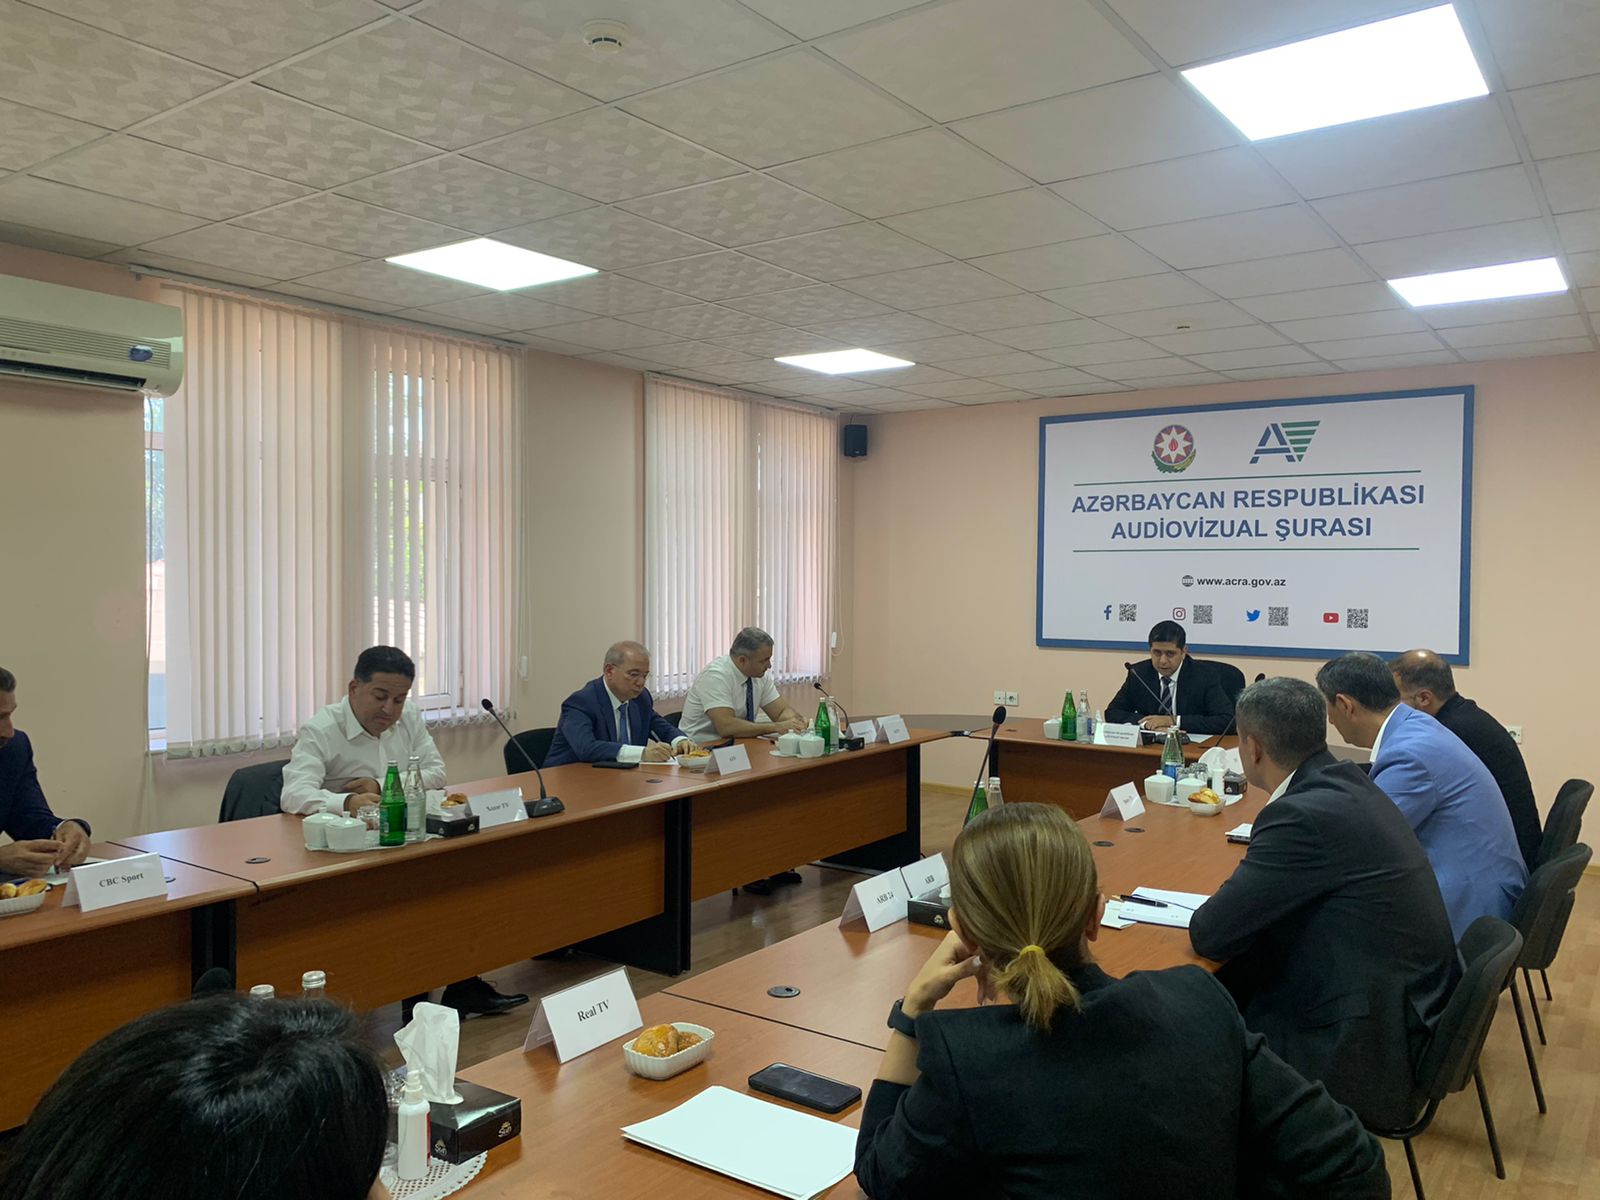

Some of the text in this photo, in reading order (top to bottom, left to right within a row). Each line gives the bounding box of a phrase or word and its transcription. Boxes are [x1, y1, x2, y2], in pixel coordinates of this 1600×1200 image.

[1071, 482, 1425, 513] AZƏRBAYCAN RESPUBLİKASI
[1111, 516, 1372, 542] AUDİOVİZUAL ŞURASI
[1196, 578, 1287, 588] www.acra.gov.az
[99, 872, 144, 888] CBC Sport
[577, 999, 609, 1022] Real TV
